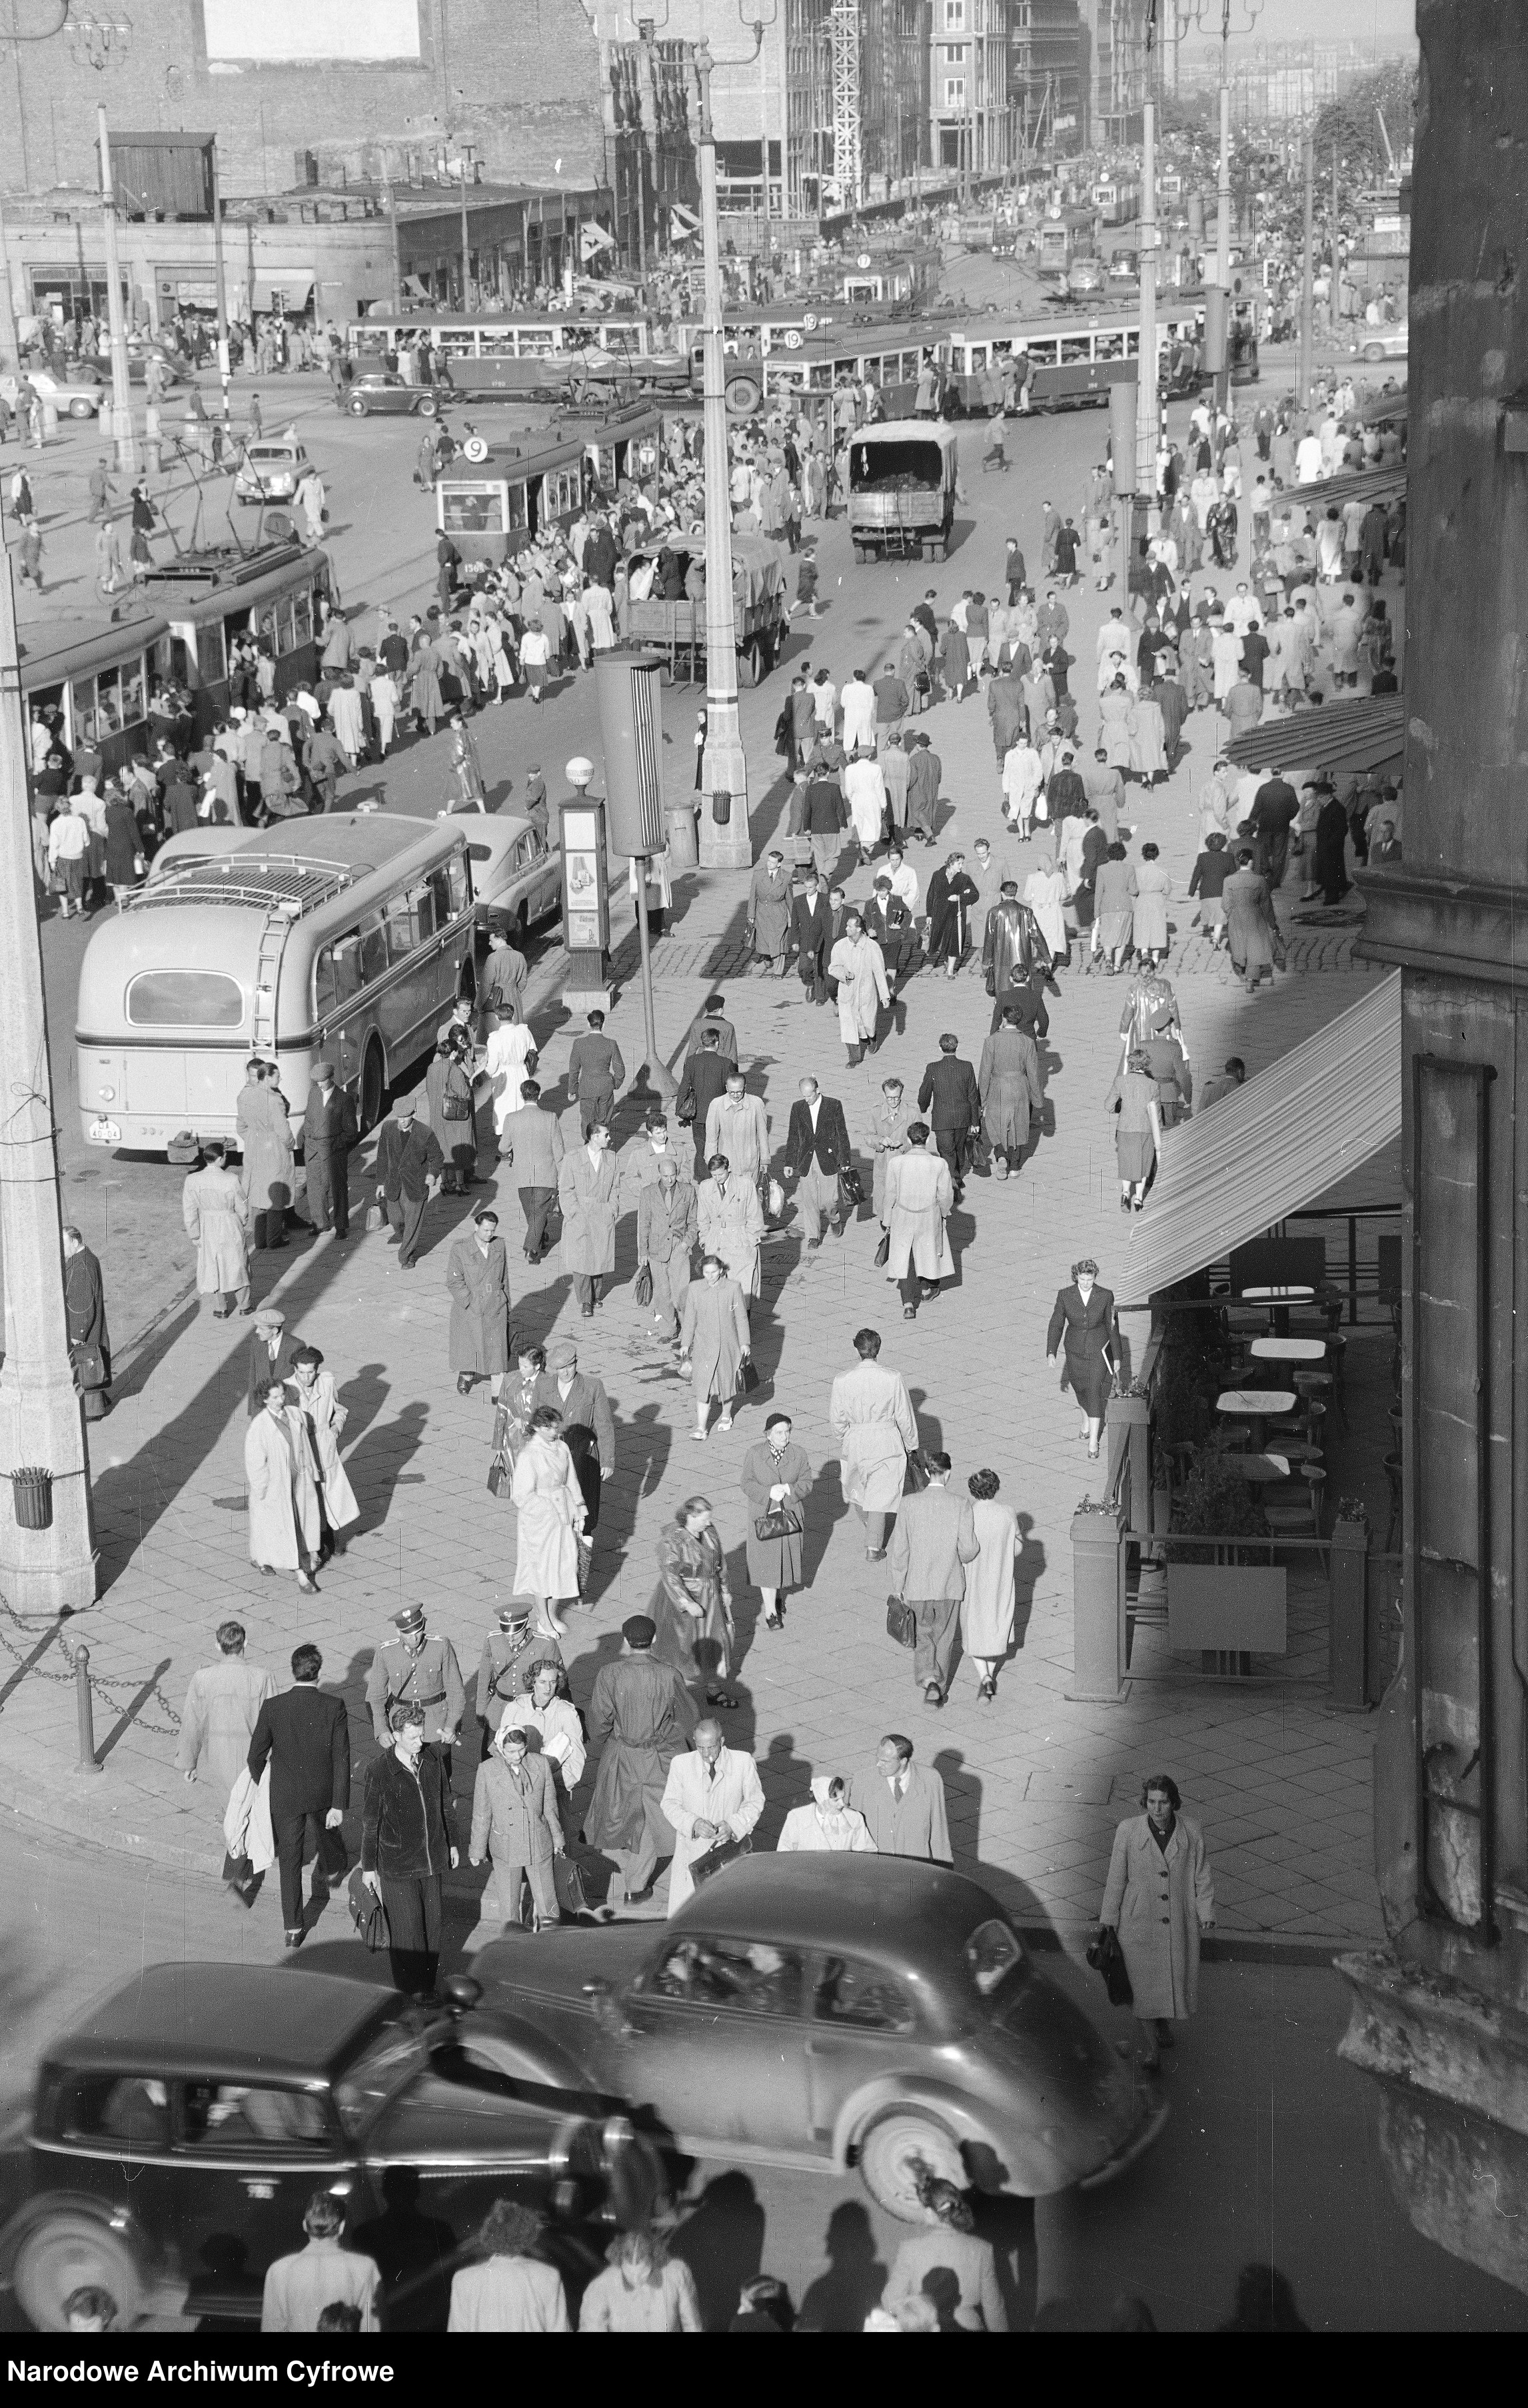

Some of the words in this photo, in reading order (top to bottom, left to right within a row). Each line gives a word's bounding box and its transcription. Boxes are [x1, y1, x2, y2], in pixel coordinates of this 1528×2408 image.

[860, 257, 868, 265] 17
[806, 316, 815, 328] 19
[788, 334, 798, 346] 19
[470, 440, 482, 458] 9
[642, 450, 653, 462] T
